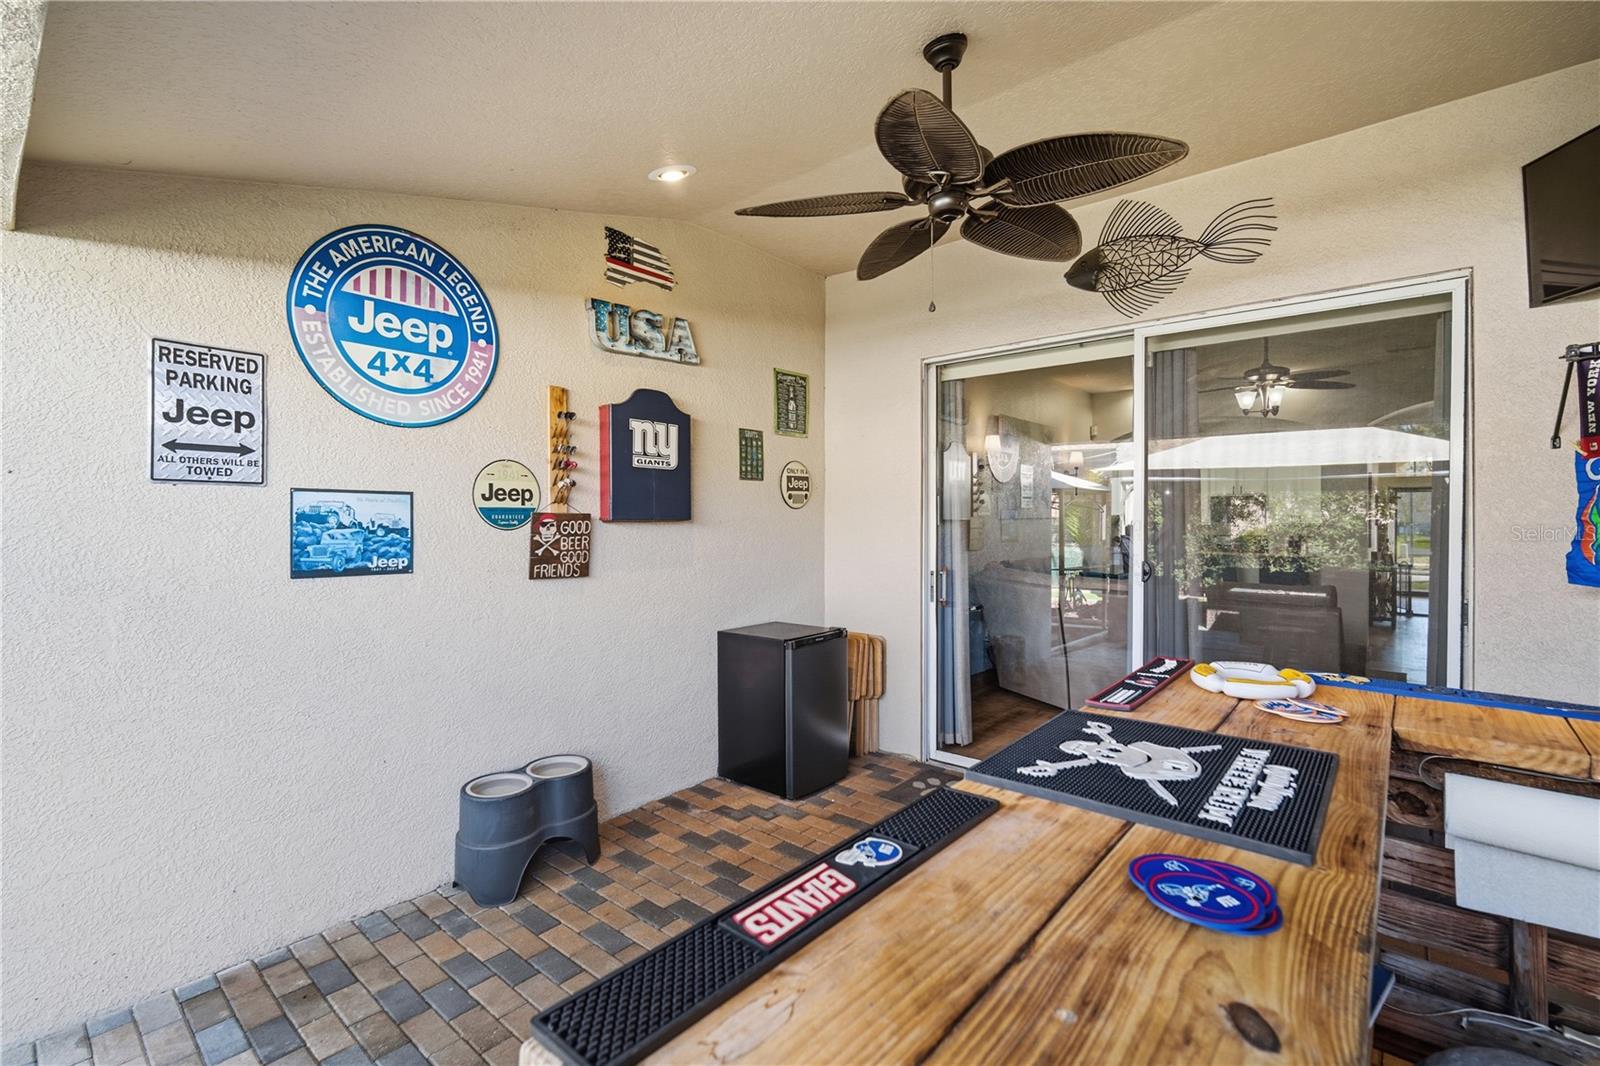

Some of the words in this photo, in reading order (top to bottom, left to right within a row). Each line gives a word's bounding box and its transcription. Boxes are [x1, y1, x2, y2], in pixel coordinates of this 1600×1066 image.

[302, 261, 334, 299] THE
[329, 235, 435, 268] AMERICAN
[438, 261, 488, 334] LEGEND
[348, 300, 454, 354] Jeep
[586, 297, 701, 365] USA
[158, 345, 259, 375] RESERVED
[301, 319, 410, 417] ESTABLISHED
[418, 383, 471, 417] SINCE
[464, 350, 489, 385] 1941
[165, 369, 252, 396] PARKING
[162, 398, 256, 434] Jeep
[1587, 401, 1596, 433] NEW
[156, 454, 177, 463] ALL
[179, 456, 219, 466] OTHERS
[221, 458, 245, 467] WILL
[247, 459, 260, 468] BE
[186, 465, 233, 477] TOWED
[636, 458, 671, 467] GIANTS
[481, 483, 534, 506] Jeep
[787, 477, 809, 491] Jeep
[560, 520, 592, 535] GOOD
[560, 536, 590, 550] BEER
[368, 555, 409, 570] Jeep
[560, 551, 590, 564] GOOD
[533, 563, 581, 578] FRIENDS
[743, 866, 857, 946] GIANTS
